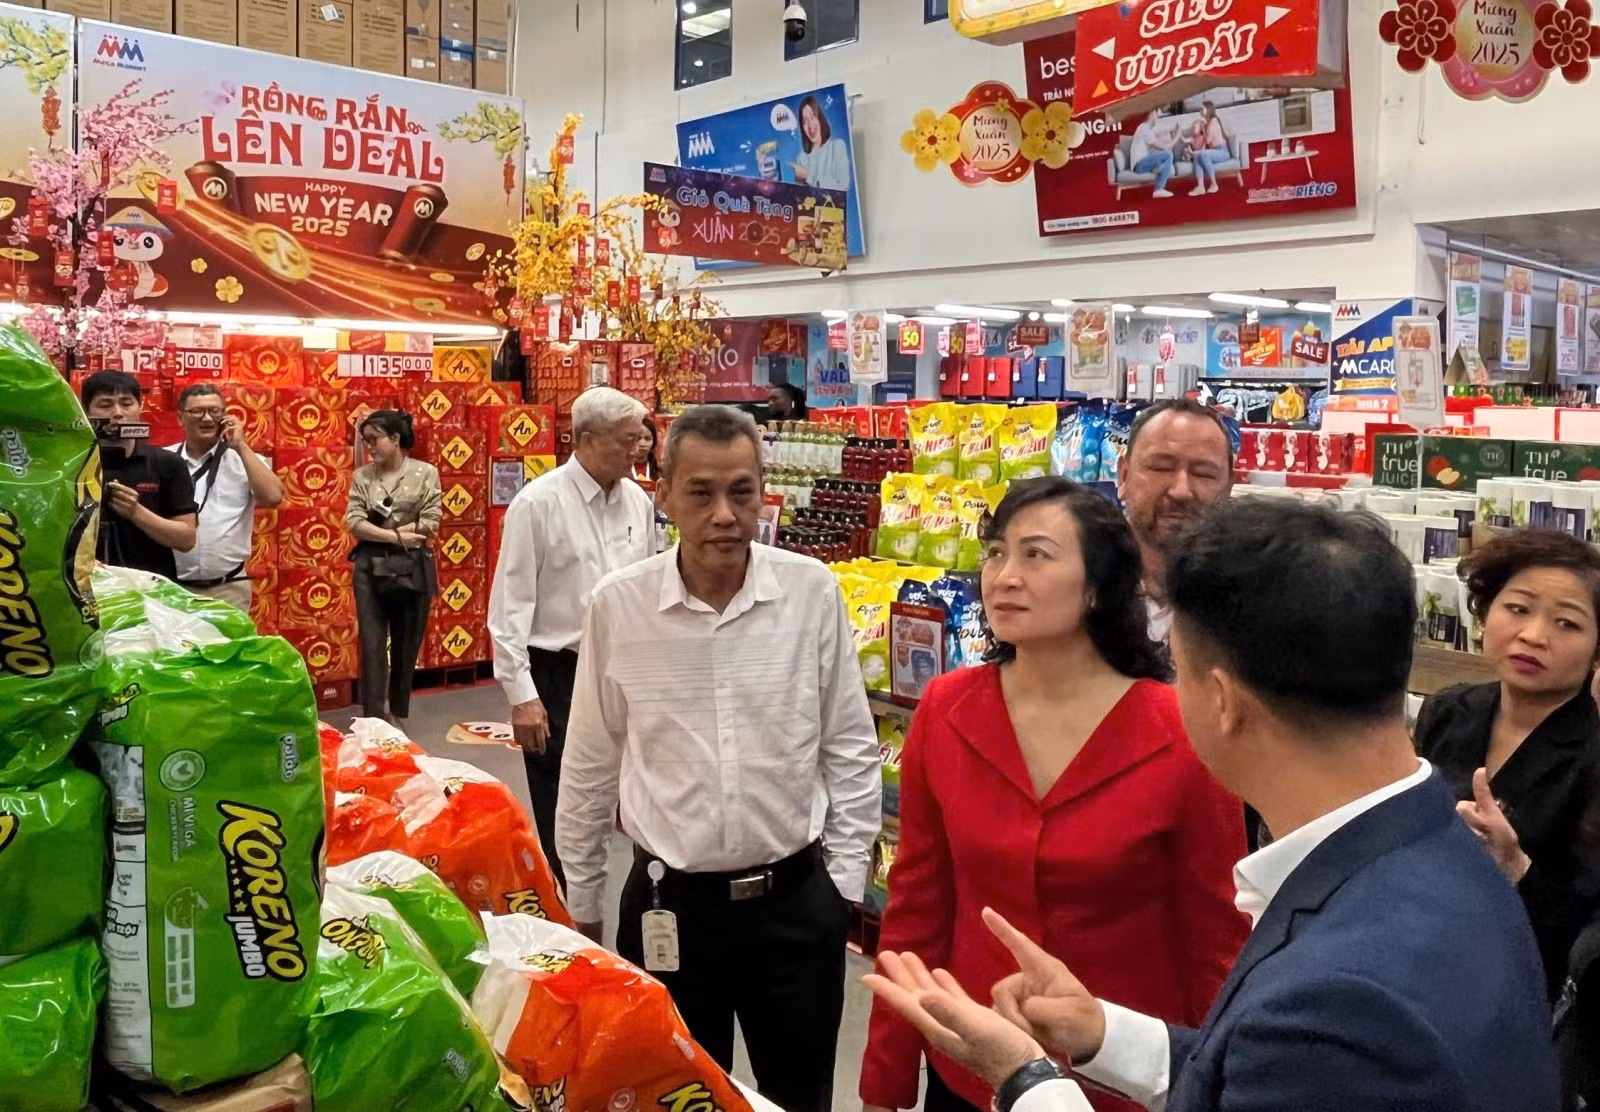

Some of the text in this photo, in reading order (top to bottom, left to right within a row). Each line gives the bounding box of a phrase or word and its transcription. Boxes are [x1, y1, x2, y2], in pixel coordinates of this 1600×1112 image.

[1476, 20, 1515, 37] Xuân
[1472, 43, 1520, 65] 2025
[242, 81, 418, 135] RỒNG RẮN
[201, 110, 444, 183] LÊN DEAL
[972, 143, 1011, 161] 2025
[305, 182, 347, 195] HAPPY
[1296, 181, 1337, 199] RIÊNG
[255, 192, 393, 227] NEW YEAR
[714, 190, 750, 213] Quà
[753, 196, 794, 222] Tặng
[291, 217, 350, 237] 2025
[692, 212, 734, 243] XUÂN
[902, 331, 920, 347] 50
[1020, 326, 1046, 338] SALE
[1295, 342, 1323, 360] SALE
[1367, 336, 1394, 353] AP
[448, 360, 470, 375] An
[821, 369, 850, 384] VAL
[426, 396, 446, 411] An
[513, 420, 533, 437] An
[447, 443, 467, 460] An
[1381, 455, 1419, 472] true
[1379, 471, 1419, 486] JUICE
[447, 491, 468, 506] An
[447, 540, 467, 556] An
[447, 586, 468, 602] An
[447, 632, 468, 649] An
[219, 801, 305, 980] KORENO
[228, 915, 267, 977] JUMBO
